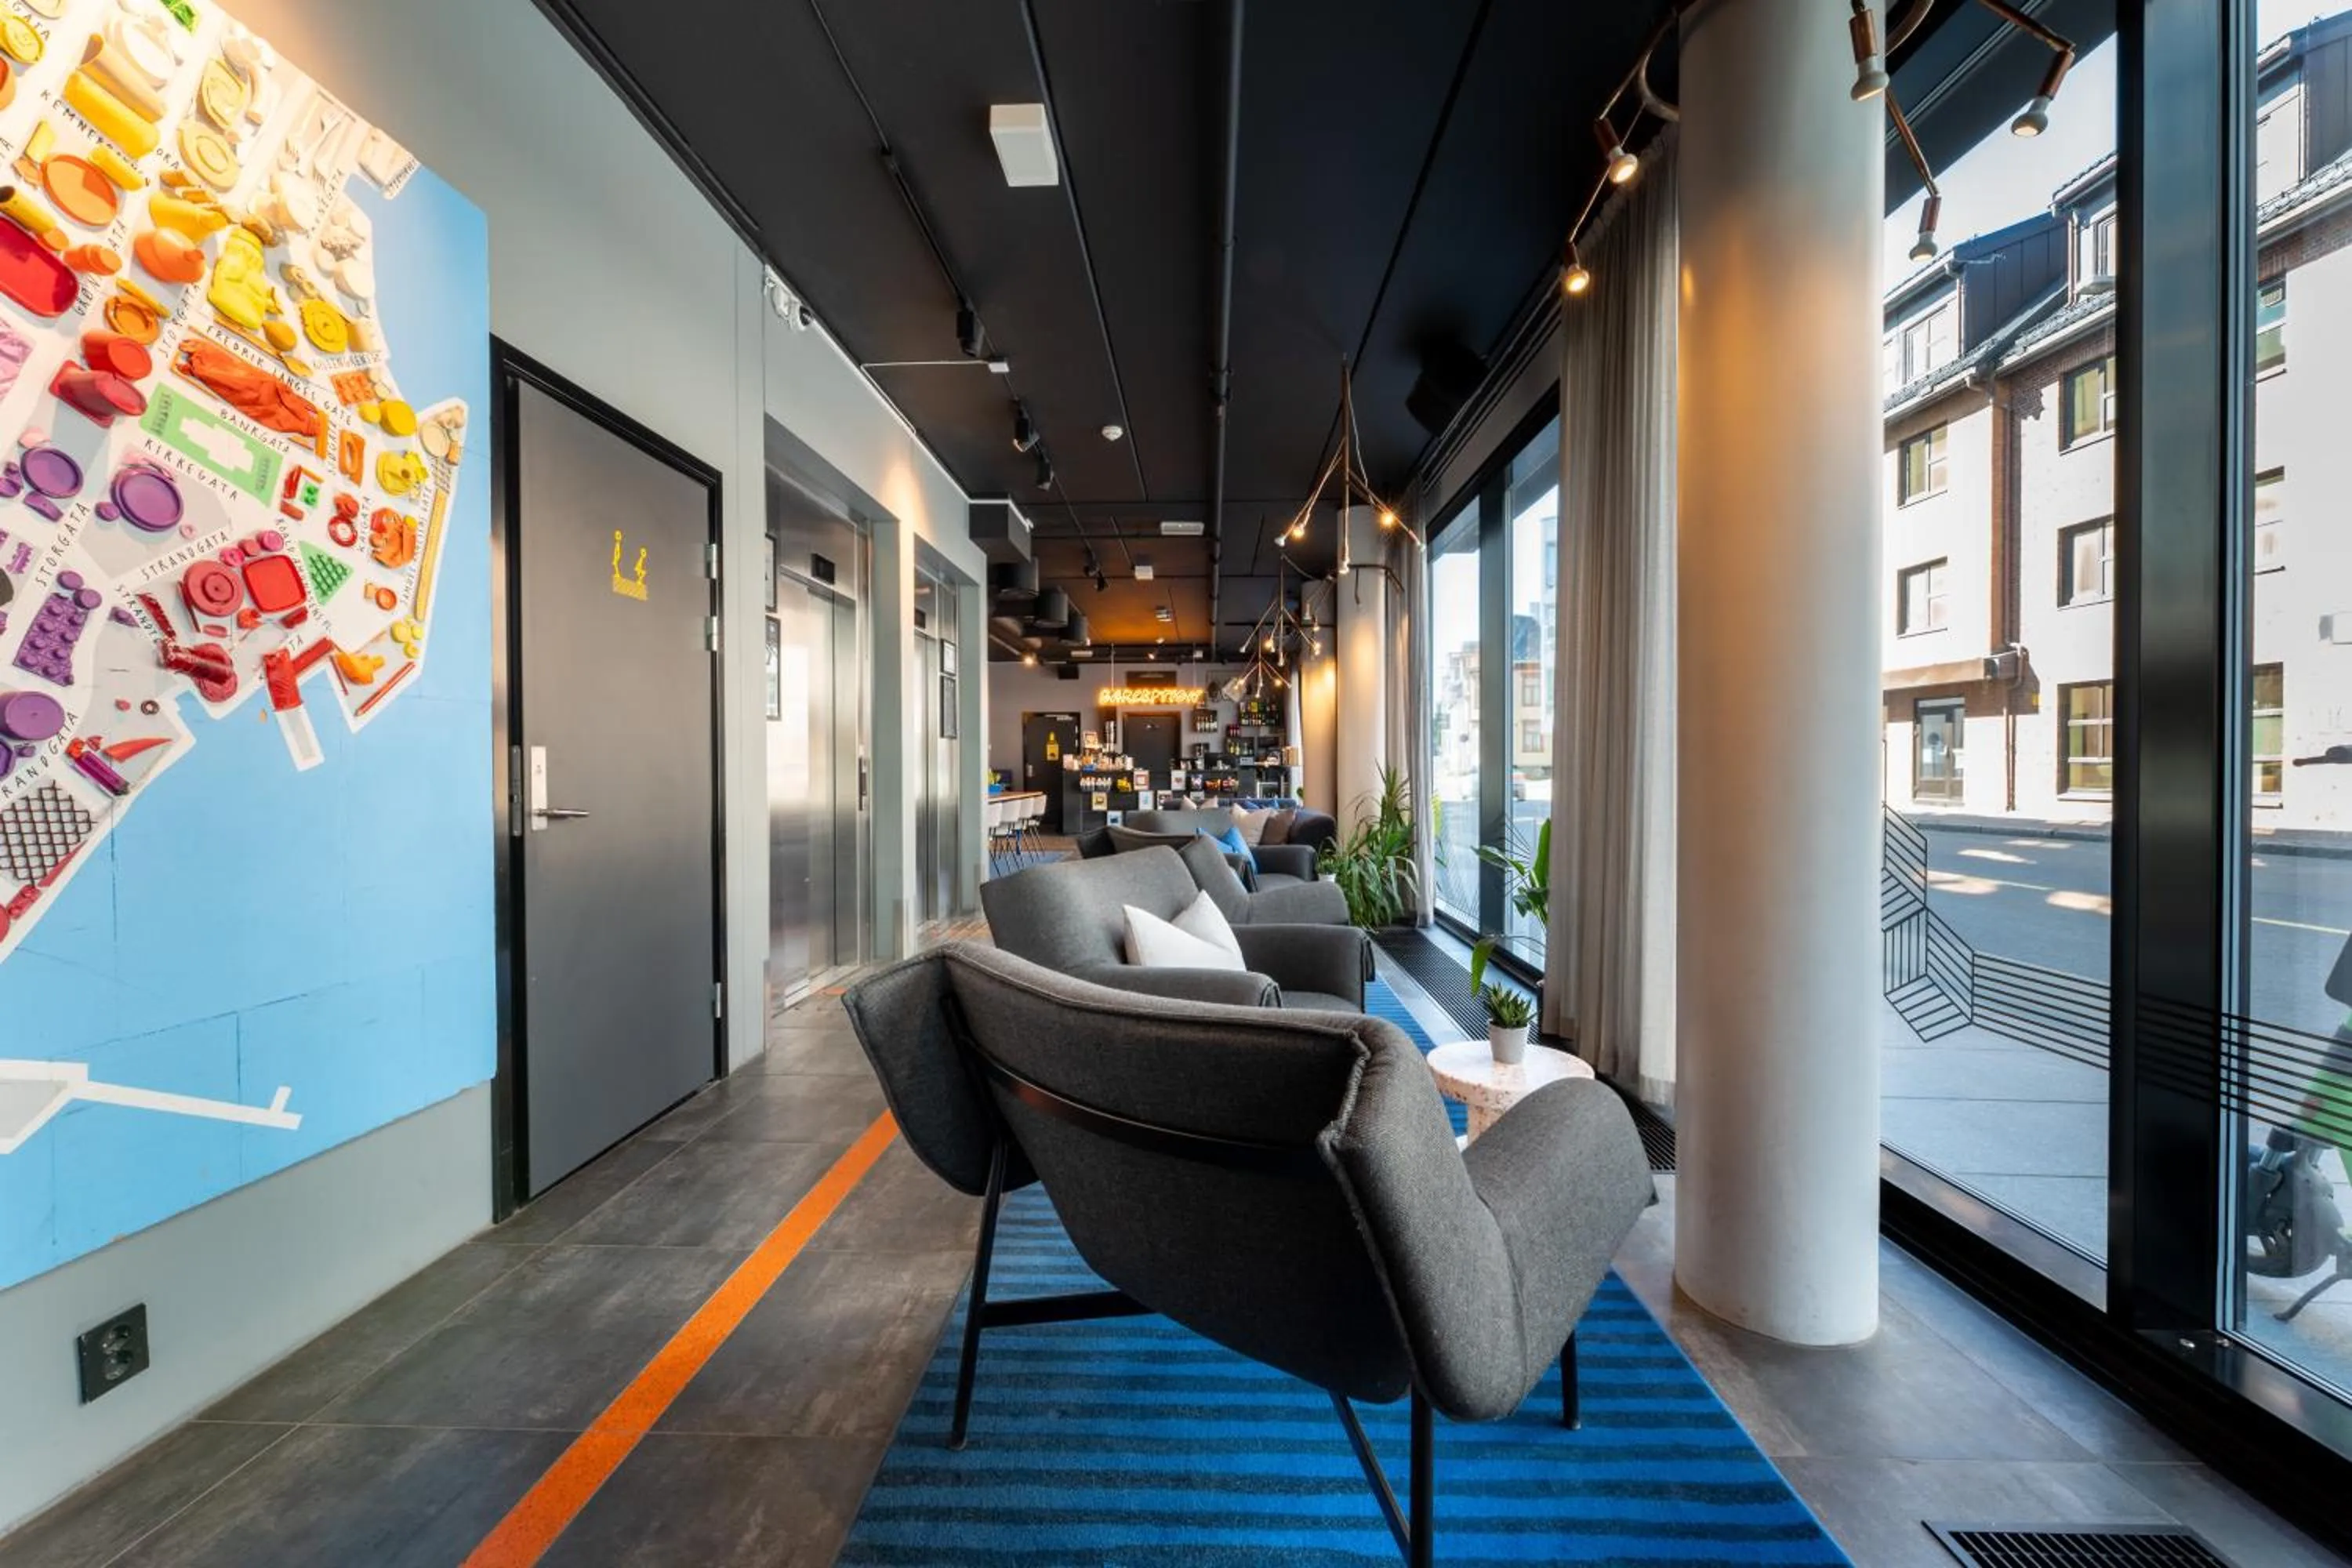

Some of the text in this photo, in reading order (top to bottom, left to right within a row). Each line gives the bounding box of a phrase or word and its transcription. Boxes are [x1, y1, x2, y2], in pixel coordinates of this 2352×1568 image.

[220, 408, 289, 452] BANKGATA
[144, 438, 238, 500] KIRKEGATA
[35, 502, 90, 587] STORGATA
[140, 531, 229, 581] STRANDGATA
